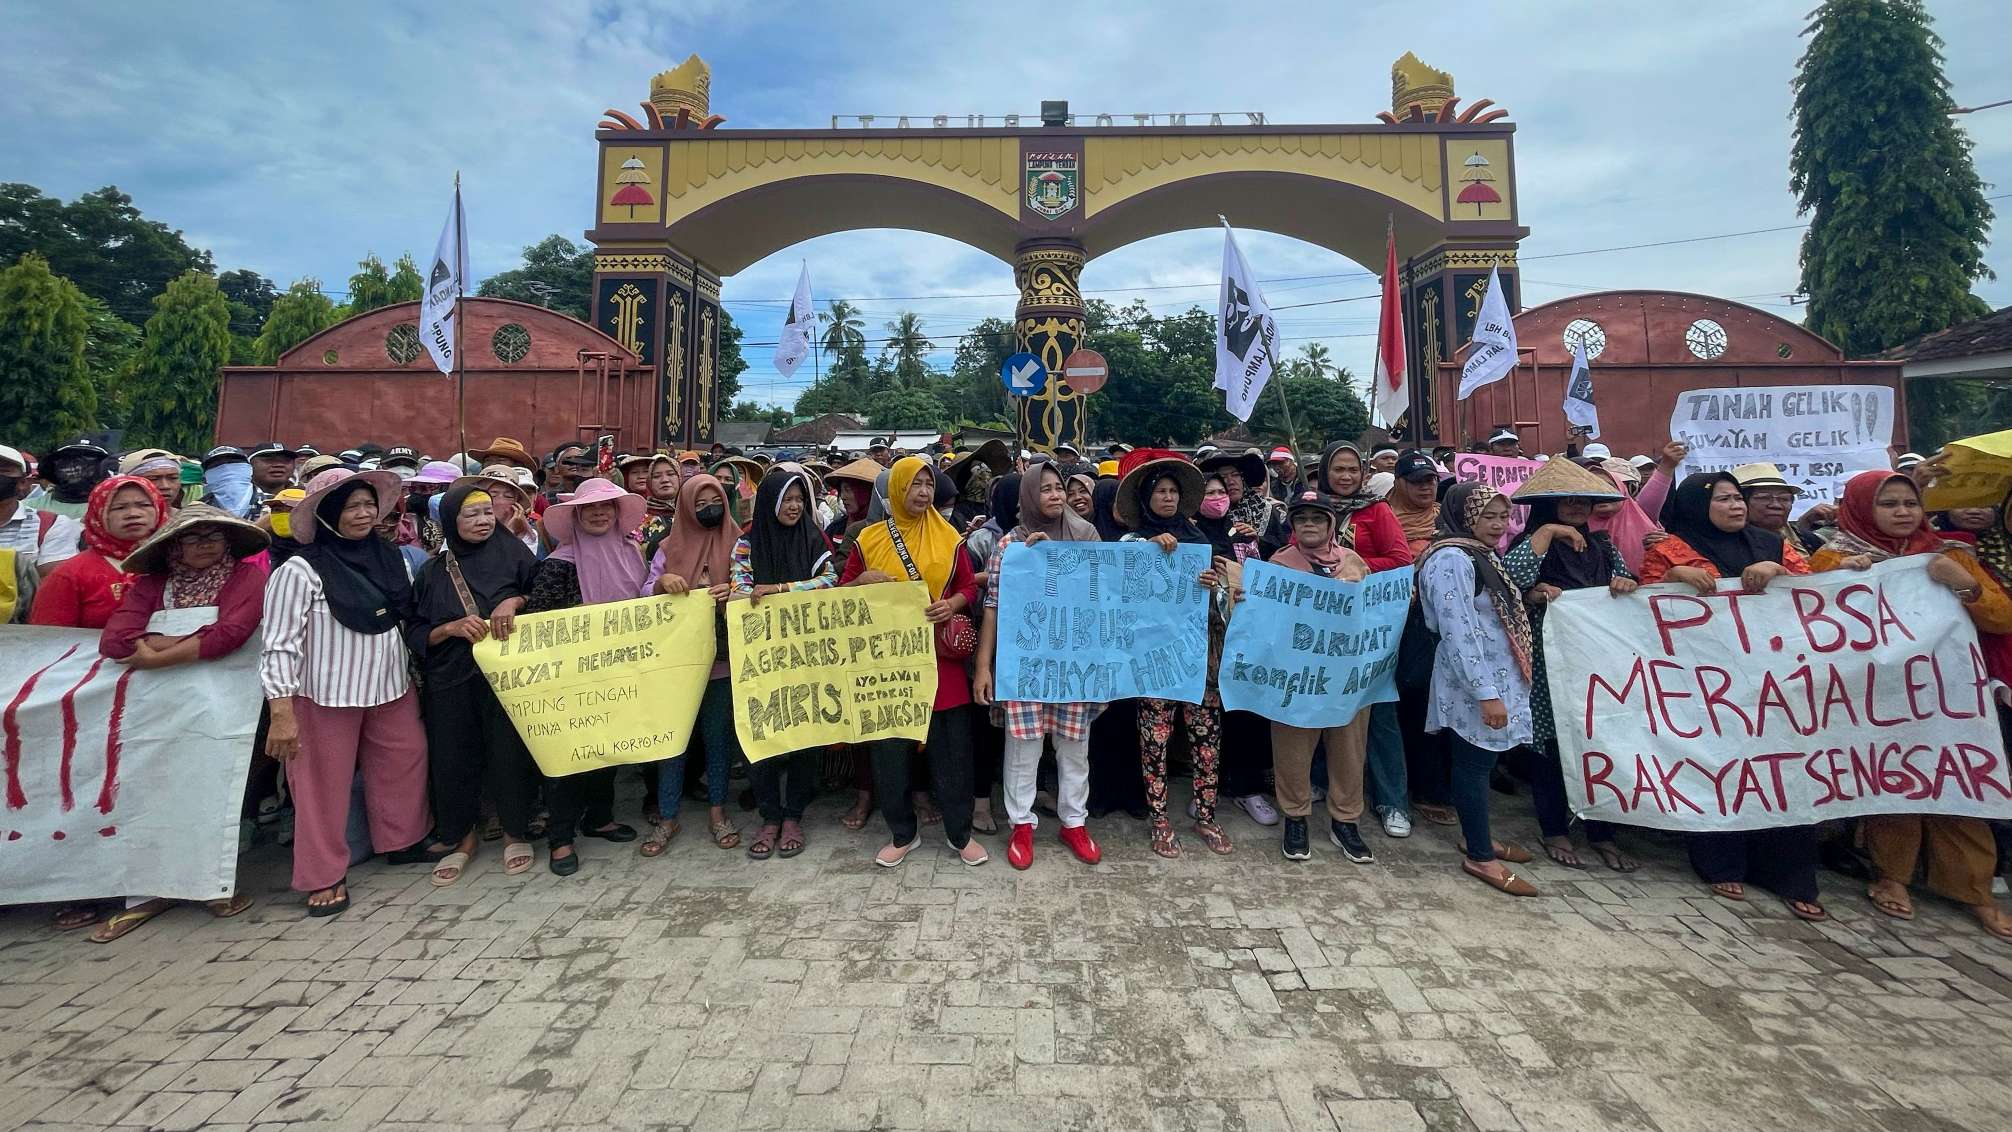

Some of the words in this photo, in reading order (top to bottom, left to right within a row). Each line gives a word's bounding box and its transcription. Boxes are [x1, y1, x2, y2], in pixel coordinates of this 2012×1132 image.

[1484, 322, 1503, 334] LBH
[1687, 393, 1772, 421] TANAH
[389, 447, 413, 456] ARMY
[1786, 430, 1849, 449] GELIK
[1808, 462, 1844, 477] BSA
[894, 538, 909, 561] YOUNG
[1121, 550, 1206, 605] BSA
[500, 613, 591, 657] TANAH
[603, 601, 674, 637] HABIS
[779, 597, 874, 639] NEGARA
[1016, 600, 1139, 652] SUBUR
[1791, 582, 1916, 653] BSA
[848, 625, 930, 664] PETANI
[1017, 656, 1123, 700] RAKYAT
[575, 685, 639, 708] TENGAH
[526, 720, 562, 738] PUNYA
[569, 711, 612, 729] RAKYAT
[570, 743, 606, 762] ATAU
[612, 730, 676, 755] KORPORAT
[1581, 752, 1805, 817] RAKYAT
